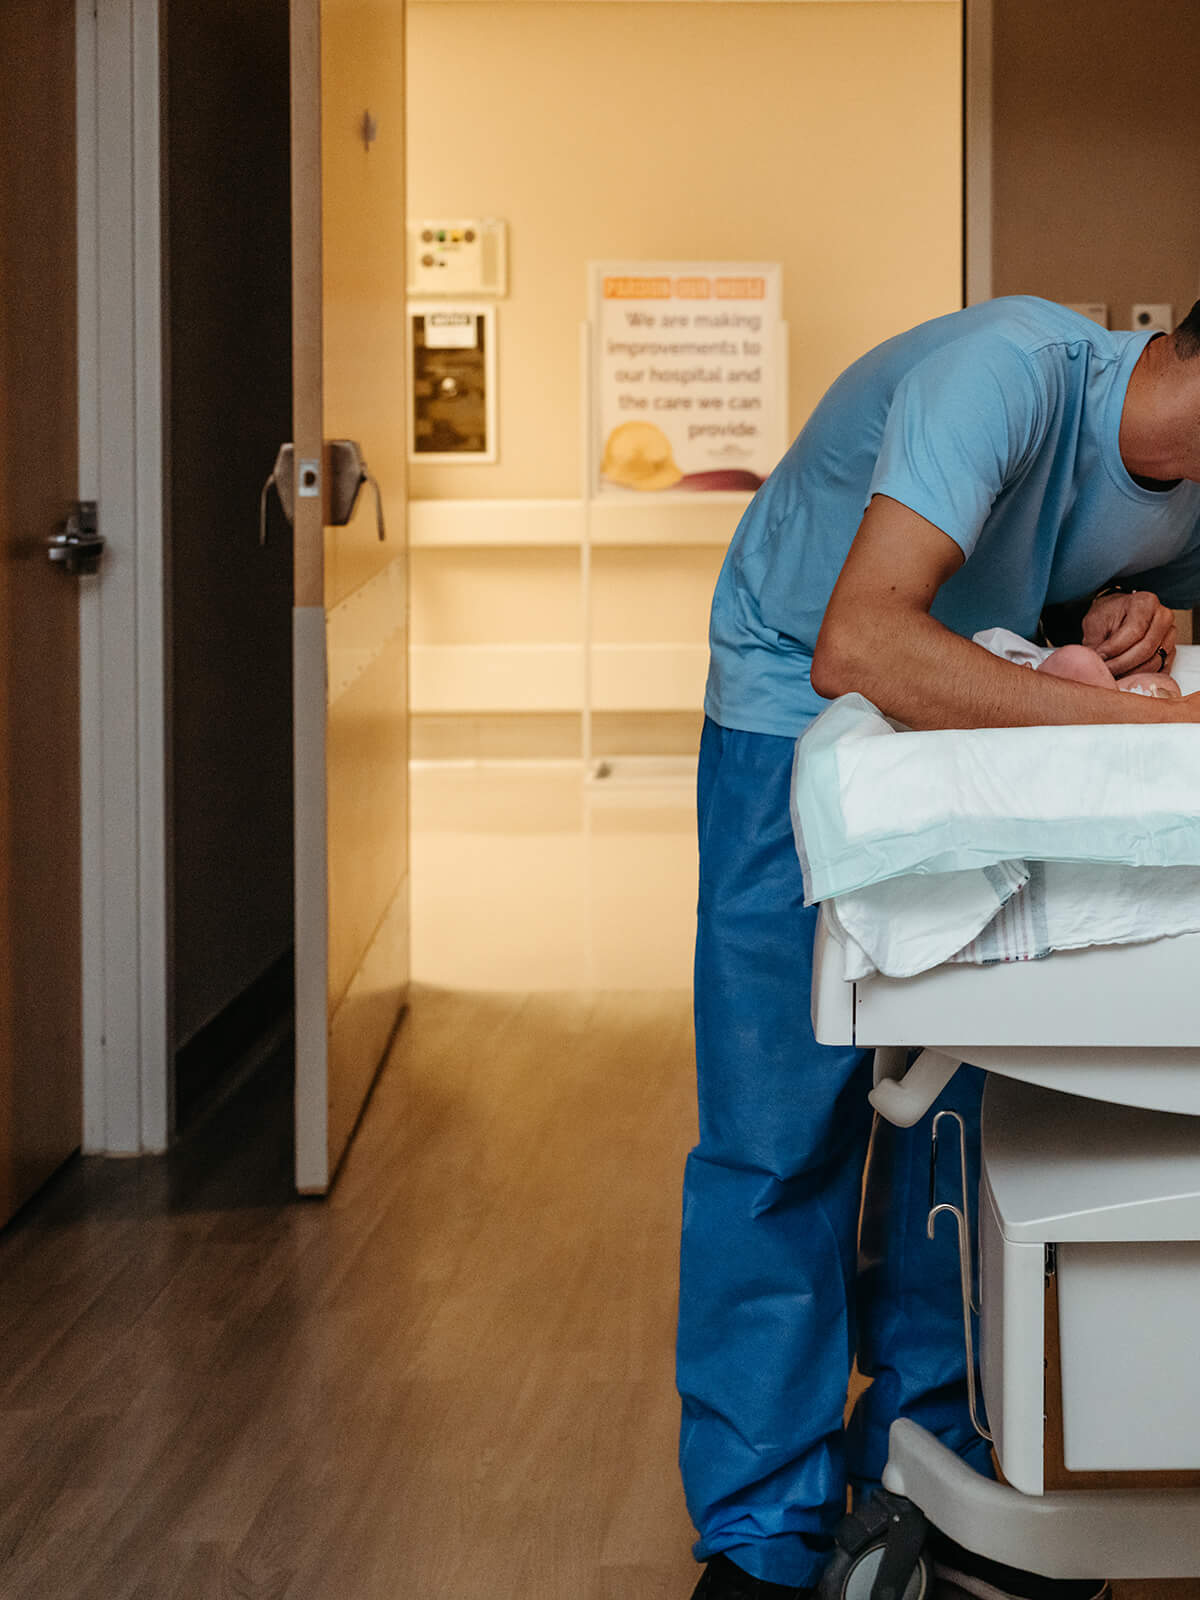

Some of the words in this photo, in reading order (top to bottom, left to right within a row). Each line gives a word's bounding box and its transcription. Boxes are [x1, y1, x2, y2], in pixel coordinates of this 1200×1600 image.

[624, 313, 655, 327] We
[661, 315, 688, 327] are
[694, 313, 761, 332] making
[608, 341, 737, 357] improvements
[743, 341, 761, 354] to
[615, 370, 644, 383] our
[650, 368, 721, 386] hospital
[727, 368, 761, 383] and
[618, 396, 647, 409] the
[653, 398, 691, 410] care
[698, 398, 723, 409] we
[728, 398, 761, 410] can
